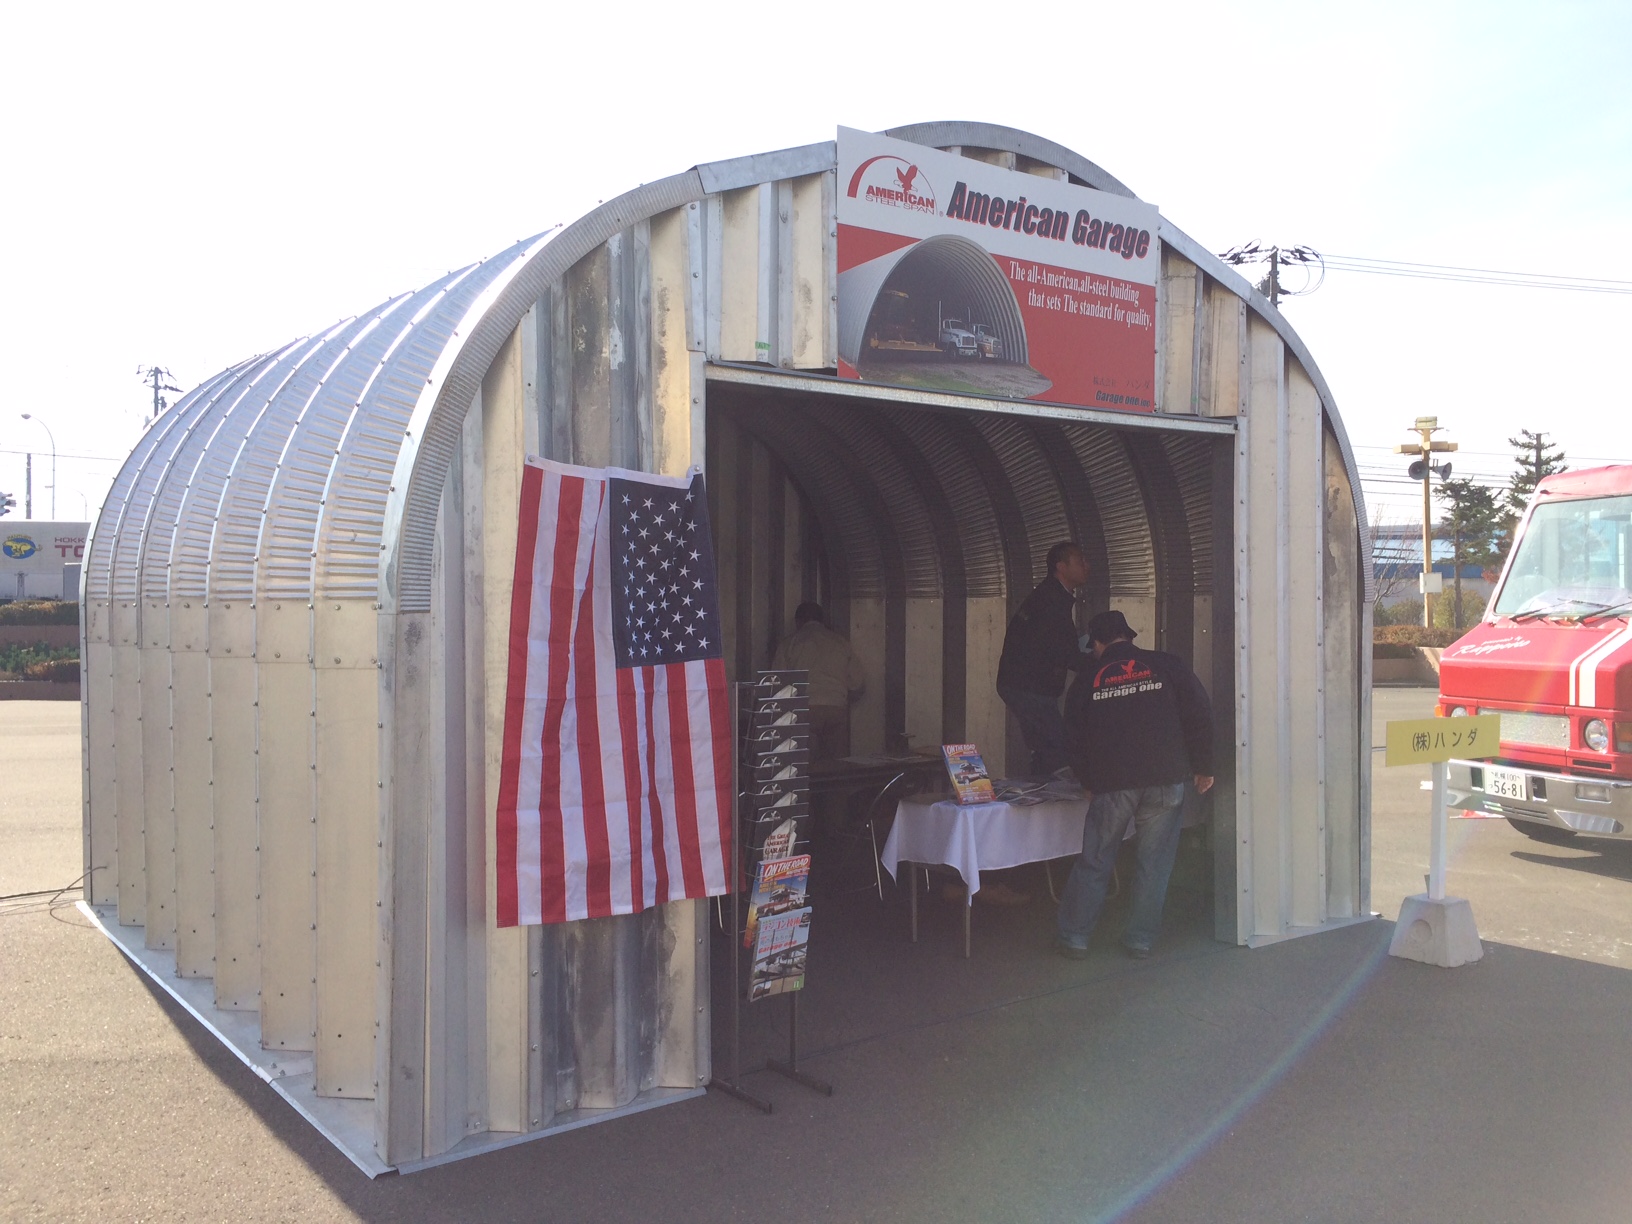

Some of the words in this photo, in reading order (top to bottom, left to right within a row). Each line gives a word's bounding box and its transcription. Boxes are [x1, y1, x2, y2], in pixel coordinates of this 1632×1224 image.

[866, 185, 934, 209] AMERICAN
[866, 194, 900, 208] STEEL
[903, 202, 934, 215] SPAN
[946, 180, 1069, 242] American
[1071, 208, 1150, 260] Garage
[1010, 261, 1025, 281] The
[1110, 281, 1140, 306] building
[1028, 288, 1045, 307] that
[1046, 293, 1062, 311] sets
[1064, 294, 1078, 314] The
[1080, 299, 1112, 320] standard
[1114, 304, 1126, 322] for
[1126, 308, 1152, 330] quality.
[1096, 390, 1124, 404] Garage
[1104, 670, 1151, 683] AMERICAN
[1092, 686, 1136, 700] Garage
[1139, 682, 1162, 692] one
[947, 745, 955, 754] ON
[1494, 780, 1523, 798] 56-81
[765, 863, 778, 878] ON
[778, 861, 791, 873] THE
[791, 857, 808, 869] ROAD
